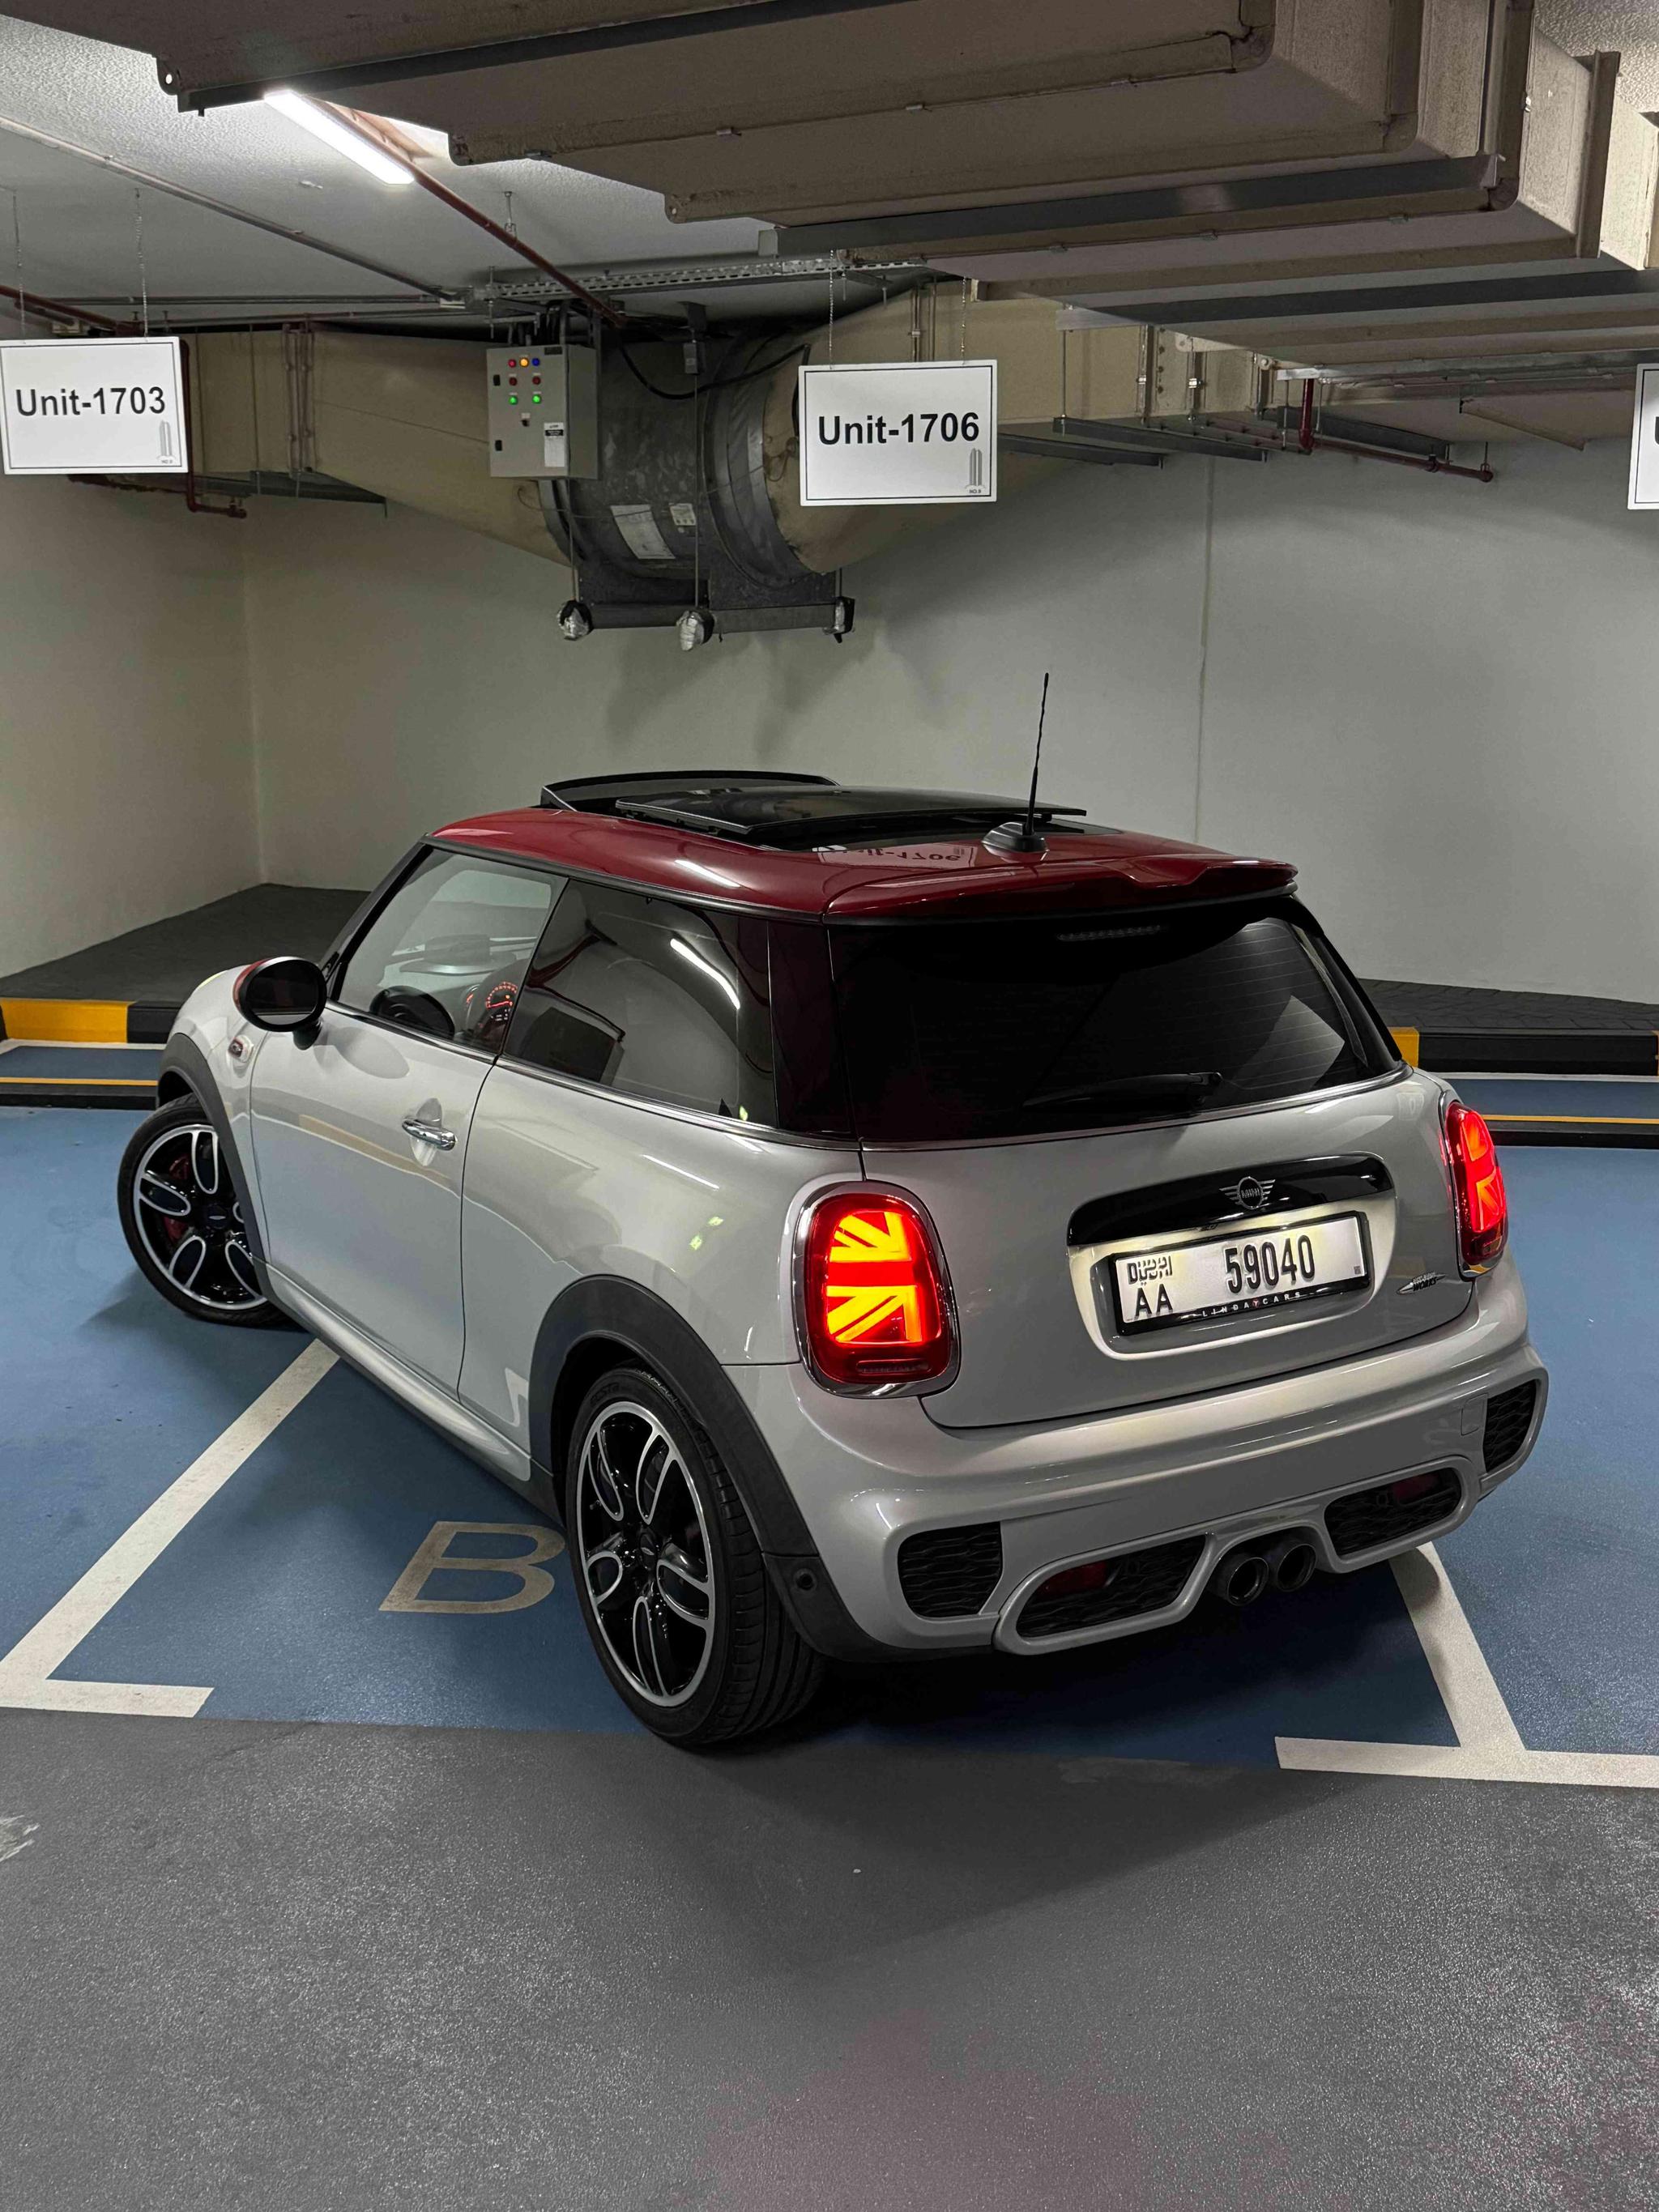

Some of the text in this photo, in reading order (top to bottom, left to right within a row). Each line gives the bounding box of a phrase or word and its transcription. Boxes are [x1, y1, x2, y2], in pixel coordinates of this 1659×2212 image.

[16, 386, 165, 416] Unit-1703
[818, 411, 979, 445] Unit-1706
[1241, 1187, 1260, 1199] MINI
[1225, 1234, 1316, 1294] 59040
[1135, 1283, 1173, 1318] AA
[1262, 1291, 1301, 1305] CARS
[378, 1520, 565, 1614] B
